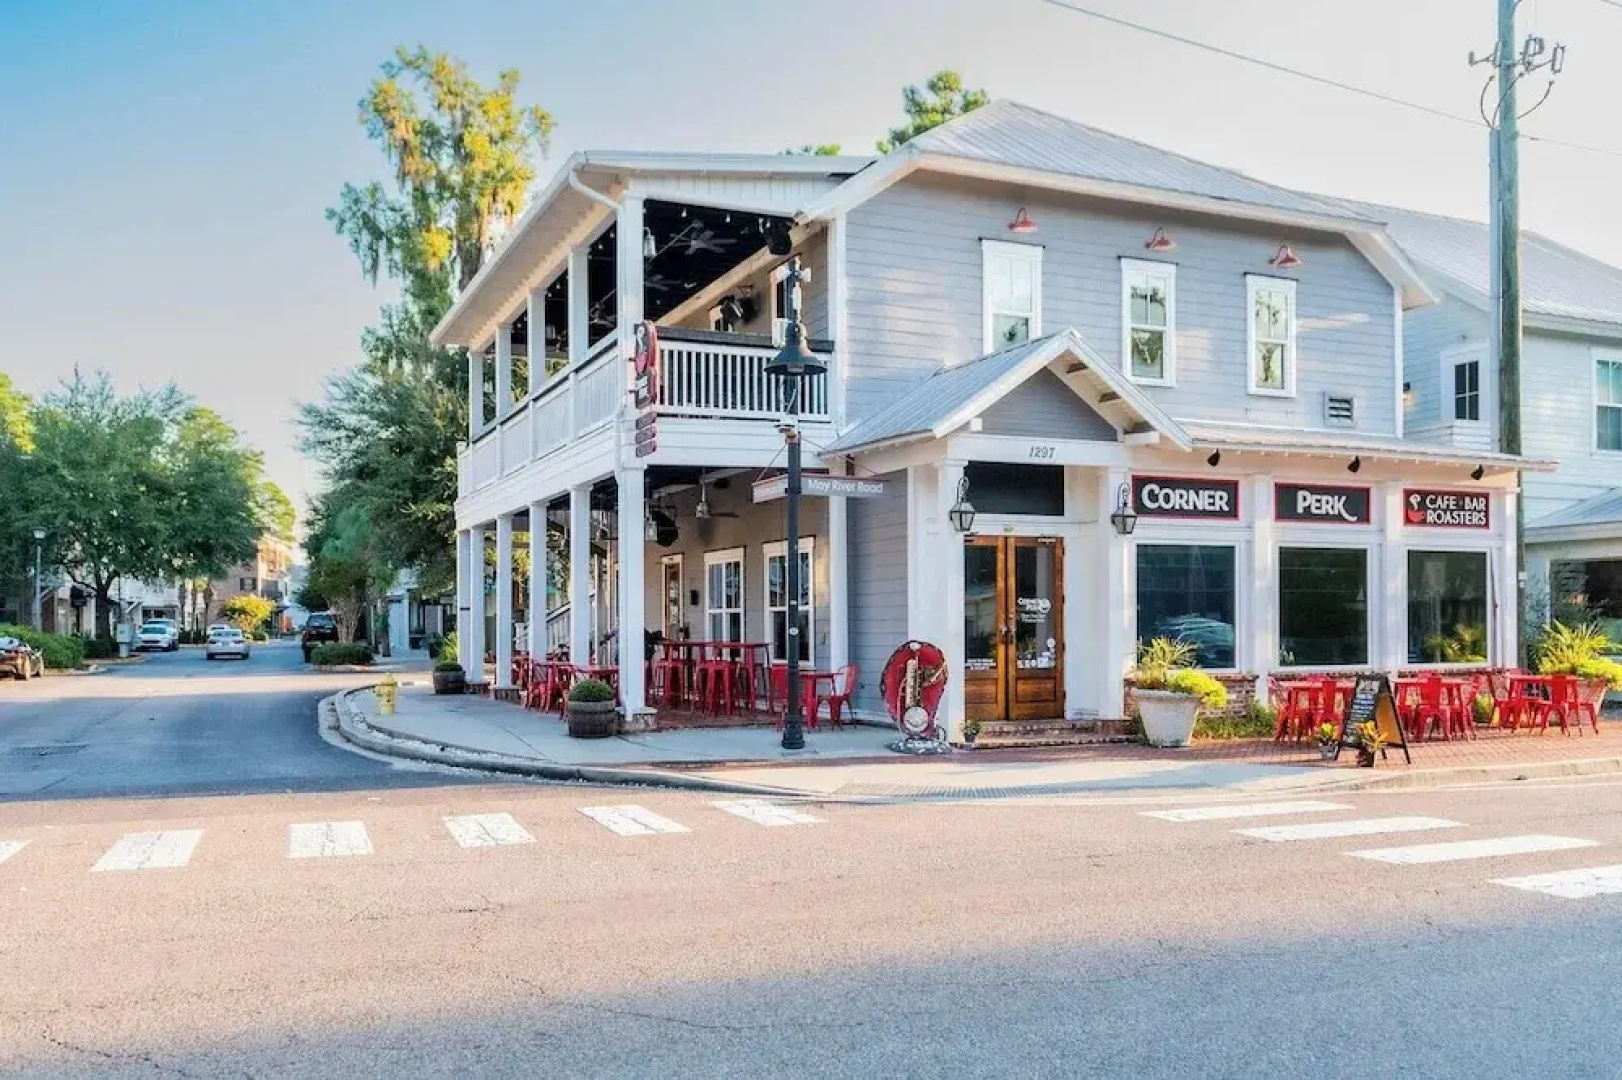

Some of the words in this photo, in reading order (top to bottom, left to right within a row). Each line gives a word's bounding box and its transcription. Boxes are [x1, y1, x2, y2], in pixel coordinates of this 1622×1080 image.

[1029, 445, 1056, 459] 1297
[808, 479, 831, 492] May
[832, 480, 855, 492] River
[858, 481, 883, 494] Road
[1141, 483, 1230, 512] CORNER
[1296, 489, 1358, 522] PERK
[1425, 494, 1457, 510] CAFE
[1464, 496, 1487, 511] BAR
[1426, 510, 1487, 526] ROASTERS
